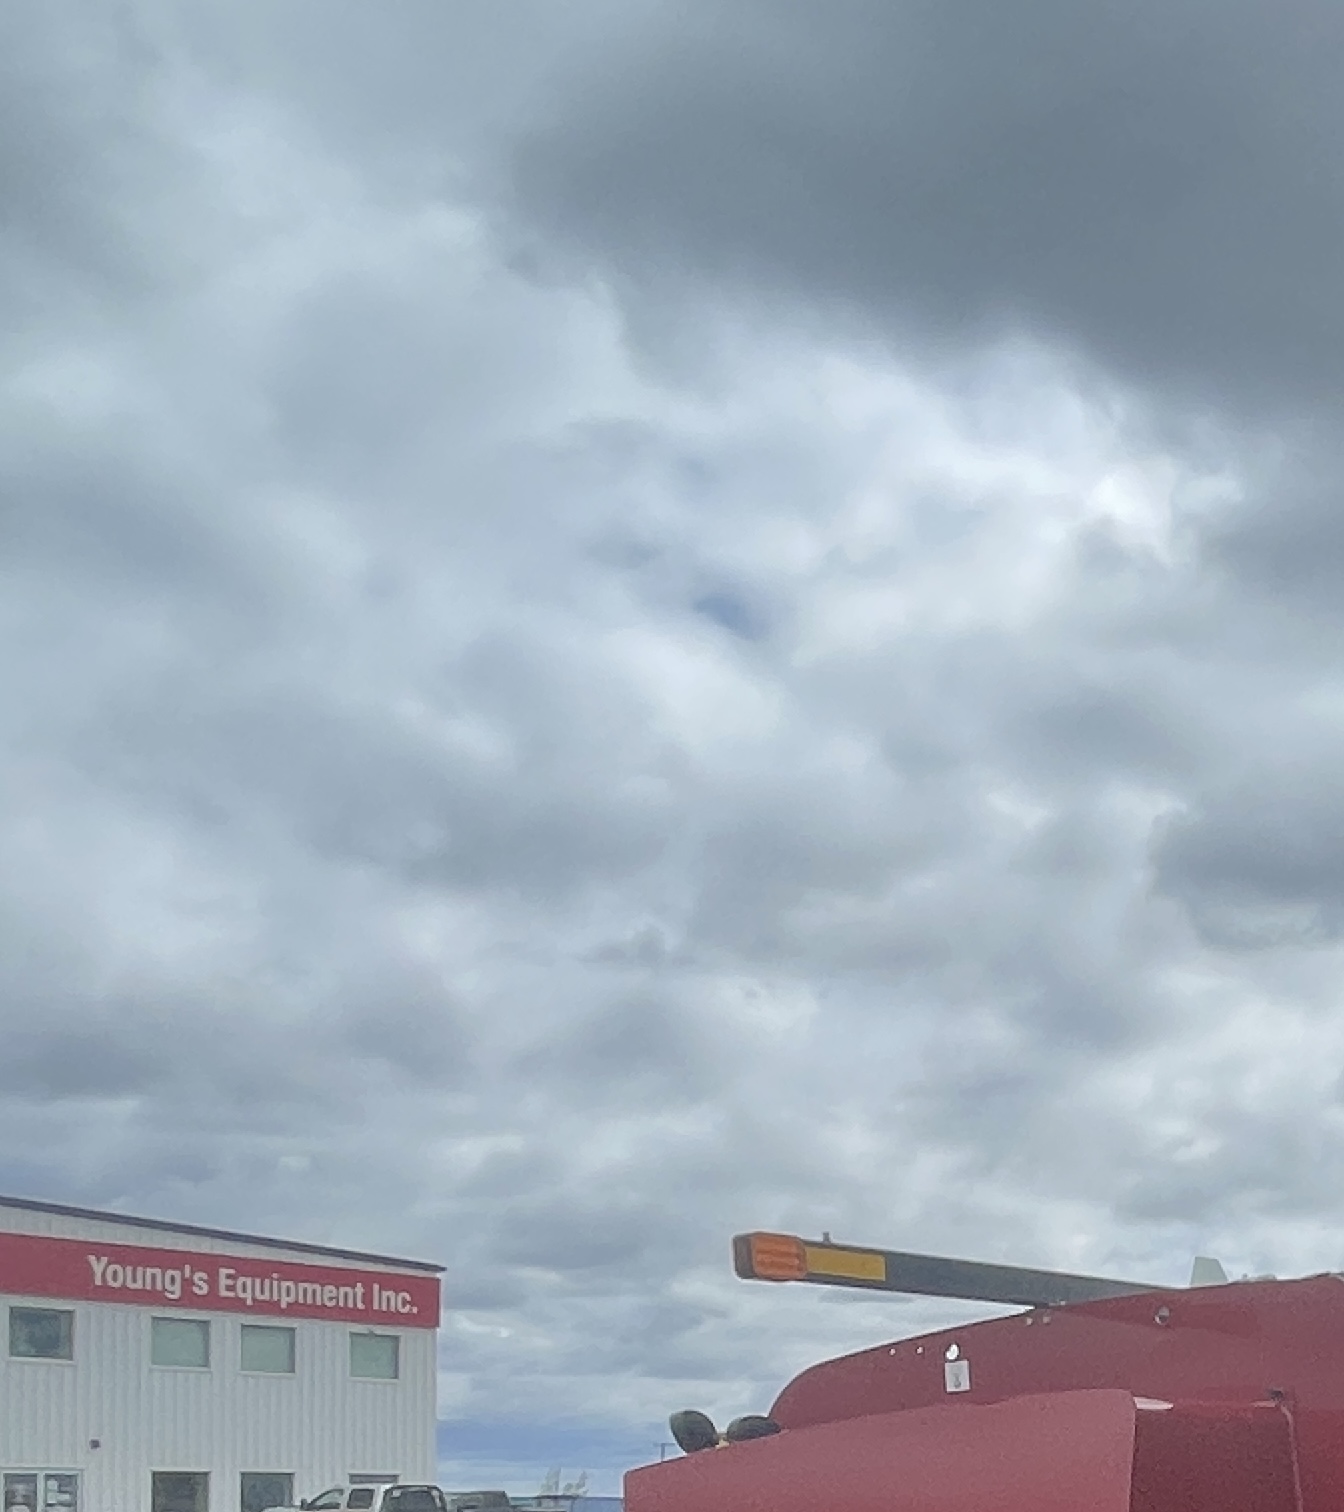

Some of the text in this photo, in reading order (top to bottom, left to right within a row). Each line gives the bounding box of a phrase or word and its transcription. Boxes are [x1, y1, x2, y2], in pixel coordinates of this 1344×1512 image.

[88, 1255, 418, 1314] Young's Equipment Inc.
